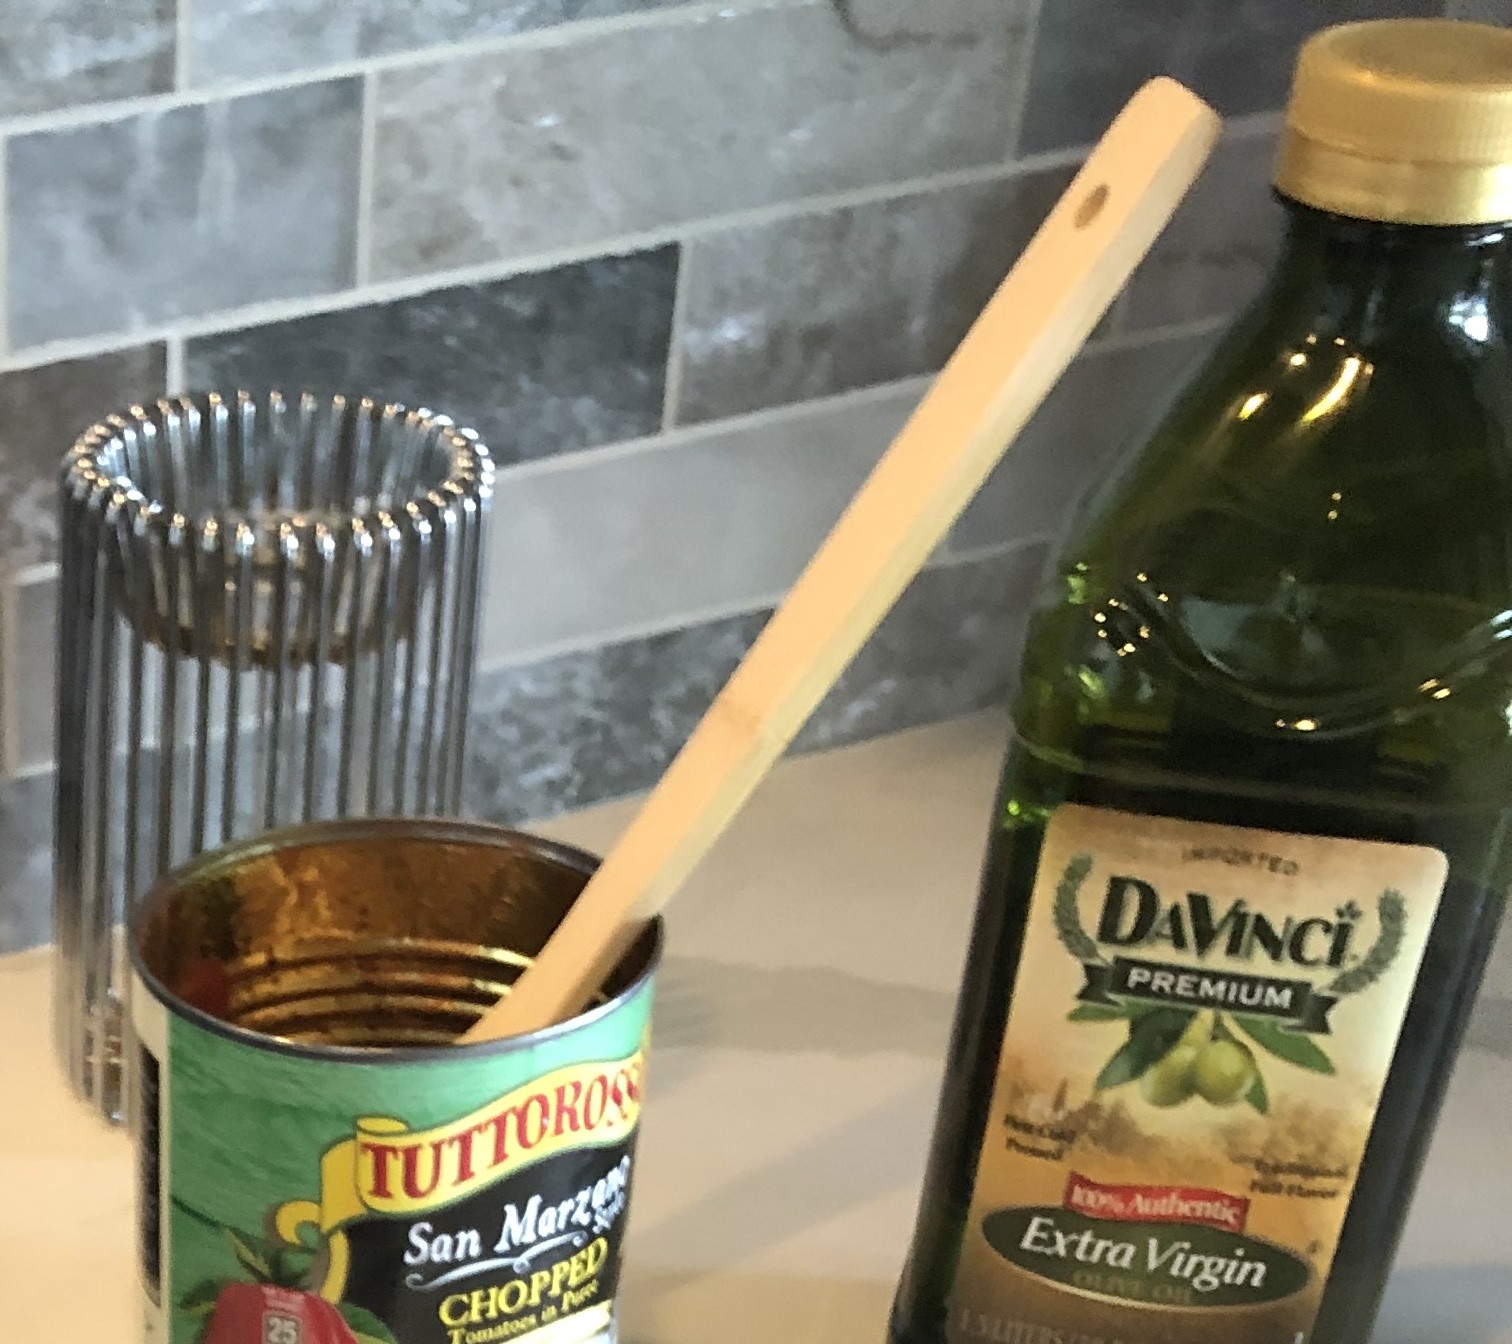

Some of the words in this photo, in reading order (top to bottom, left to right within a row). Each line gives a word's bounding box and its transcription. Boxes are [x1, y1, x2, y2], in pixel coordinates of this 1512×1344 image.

[1126, 966, 1294, 1010] PREMIUM
[1071, 1183, 1125, 1213] 100%
[1125, 1190, 1240, 1225] Authentic
[403, 1221, 482, 1266] San
[1019, 1216, 1137, 1270] Extra
[1146, 1237, 1268, 1292] Virgin
[439, 1237, 609, 1328] CHOPPED
